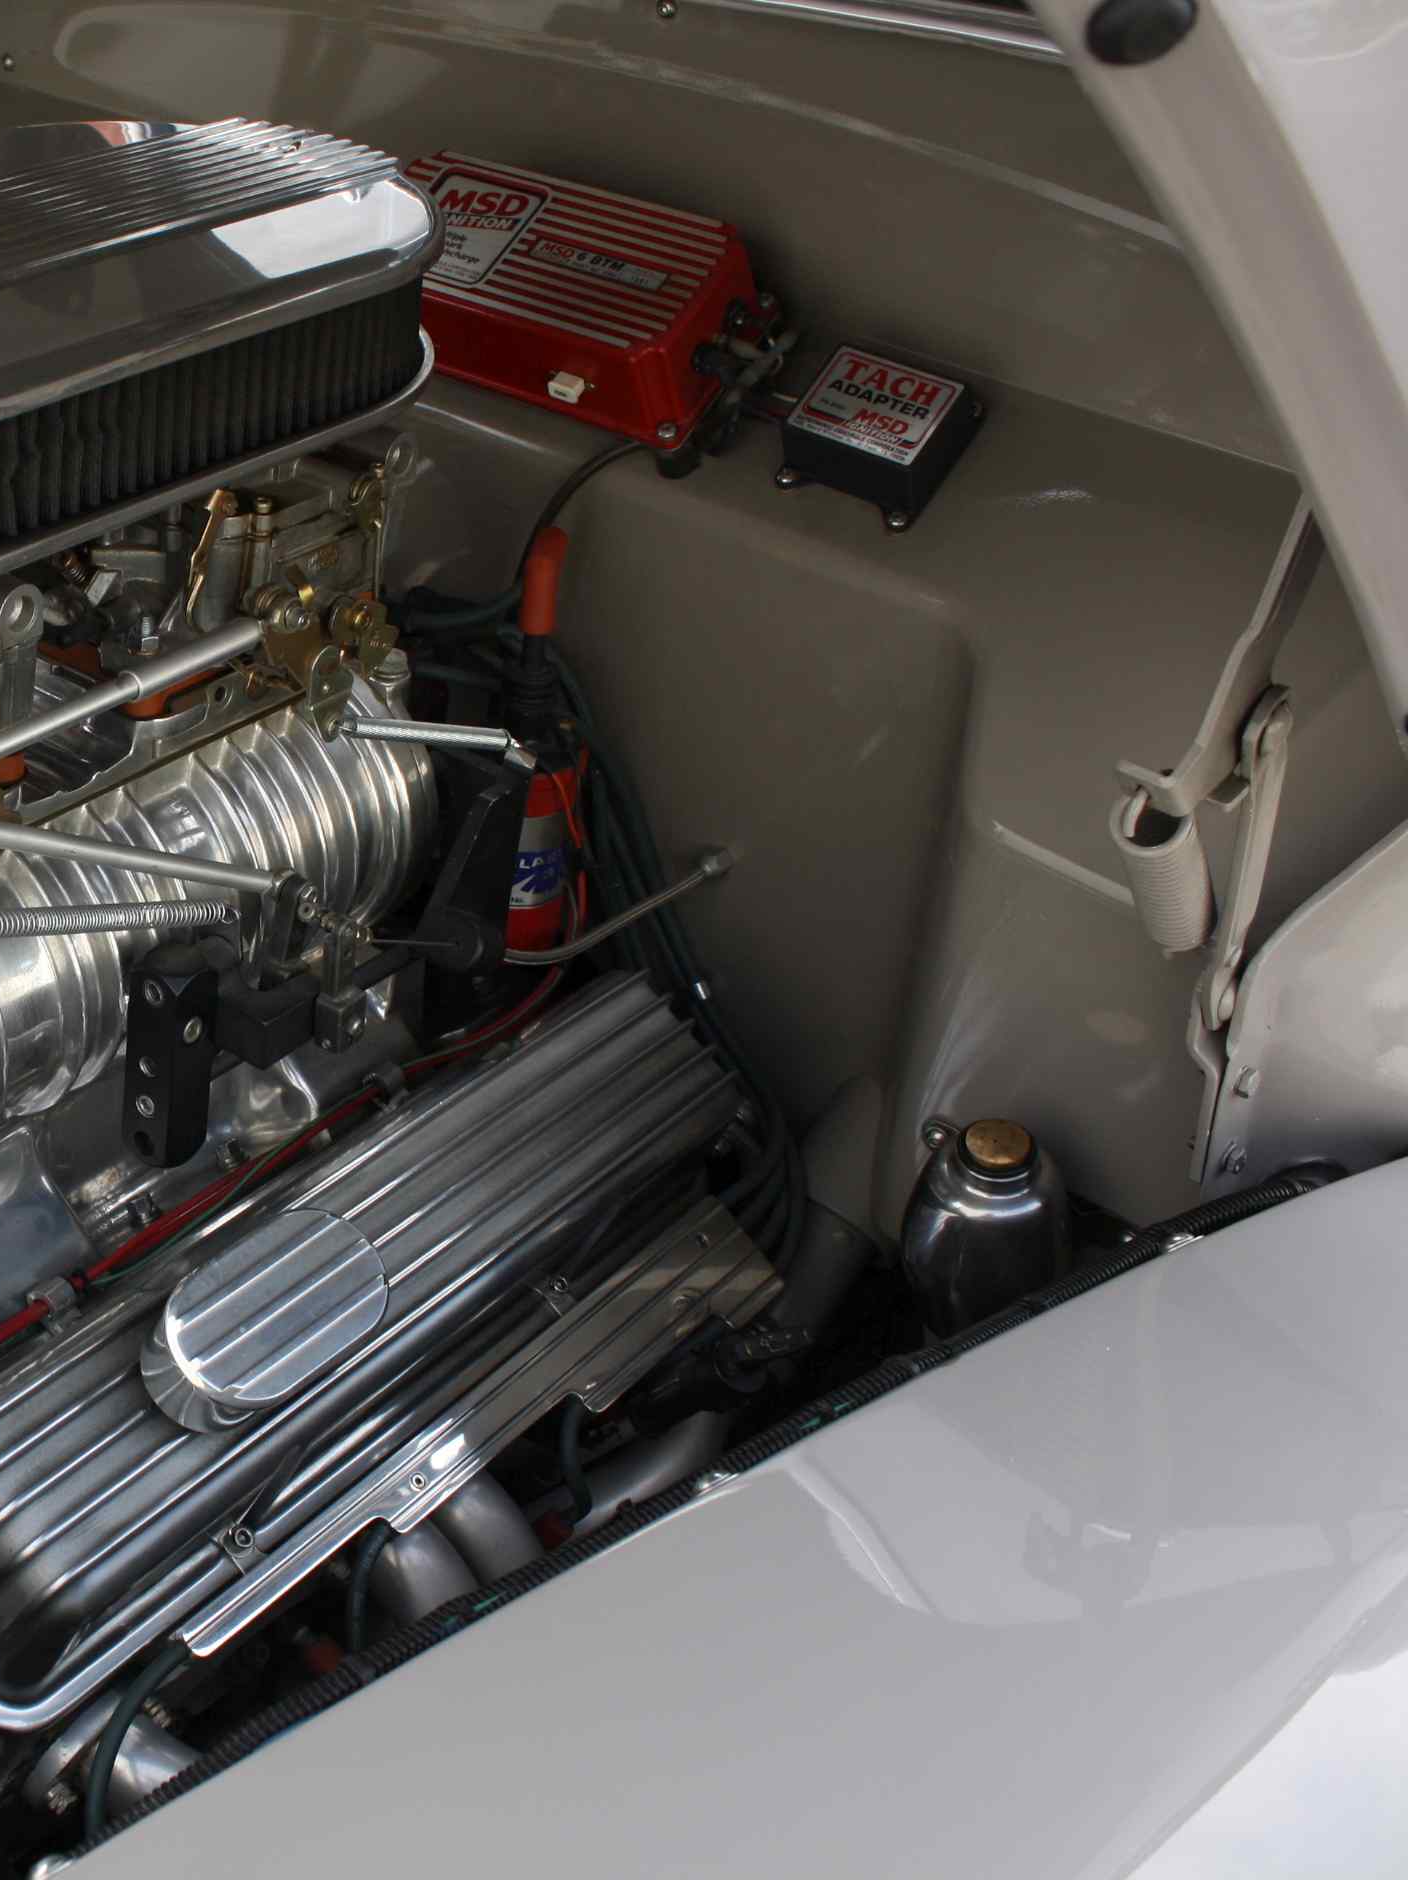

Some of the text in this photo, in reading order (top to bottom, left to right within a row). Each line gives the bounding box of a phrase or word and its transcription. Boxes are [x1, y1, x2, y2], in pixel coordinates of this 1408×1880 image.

[438, 189, 529, 216] MSD
[446, 214, 513, 230] NITION
[540, 242, 575, 259] MSD
[589, 255, 626, 271] BTM
[844, 359, 942, 407] TACH
[828, 379, 930, 420] ADAPTER
[852, 407, 909, 435] MSD
